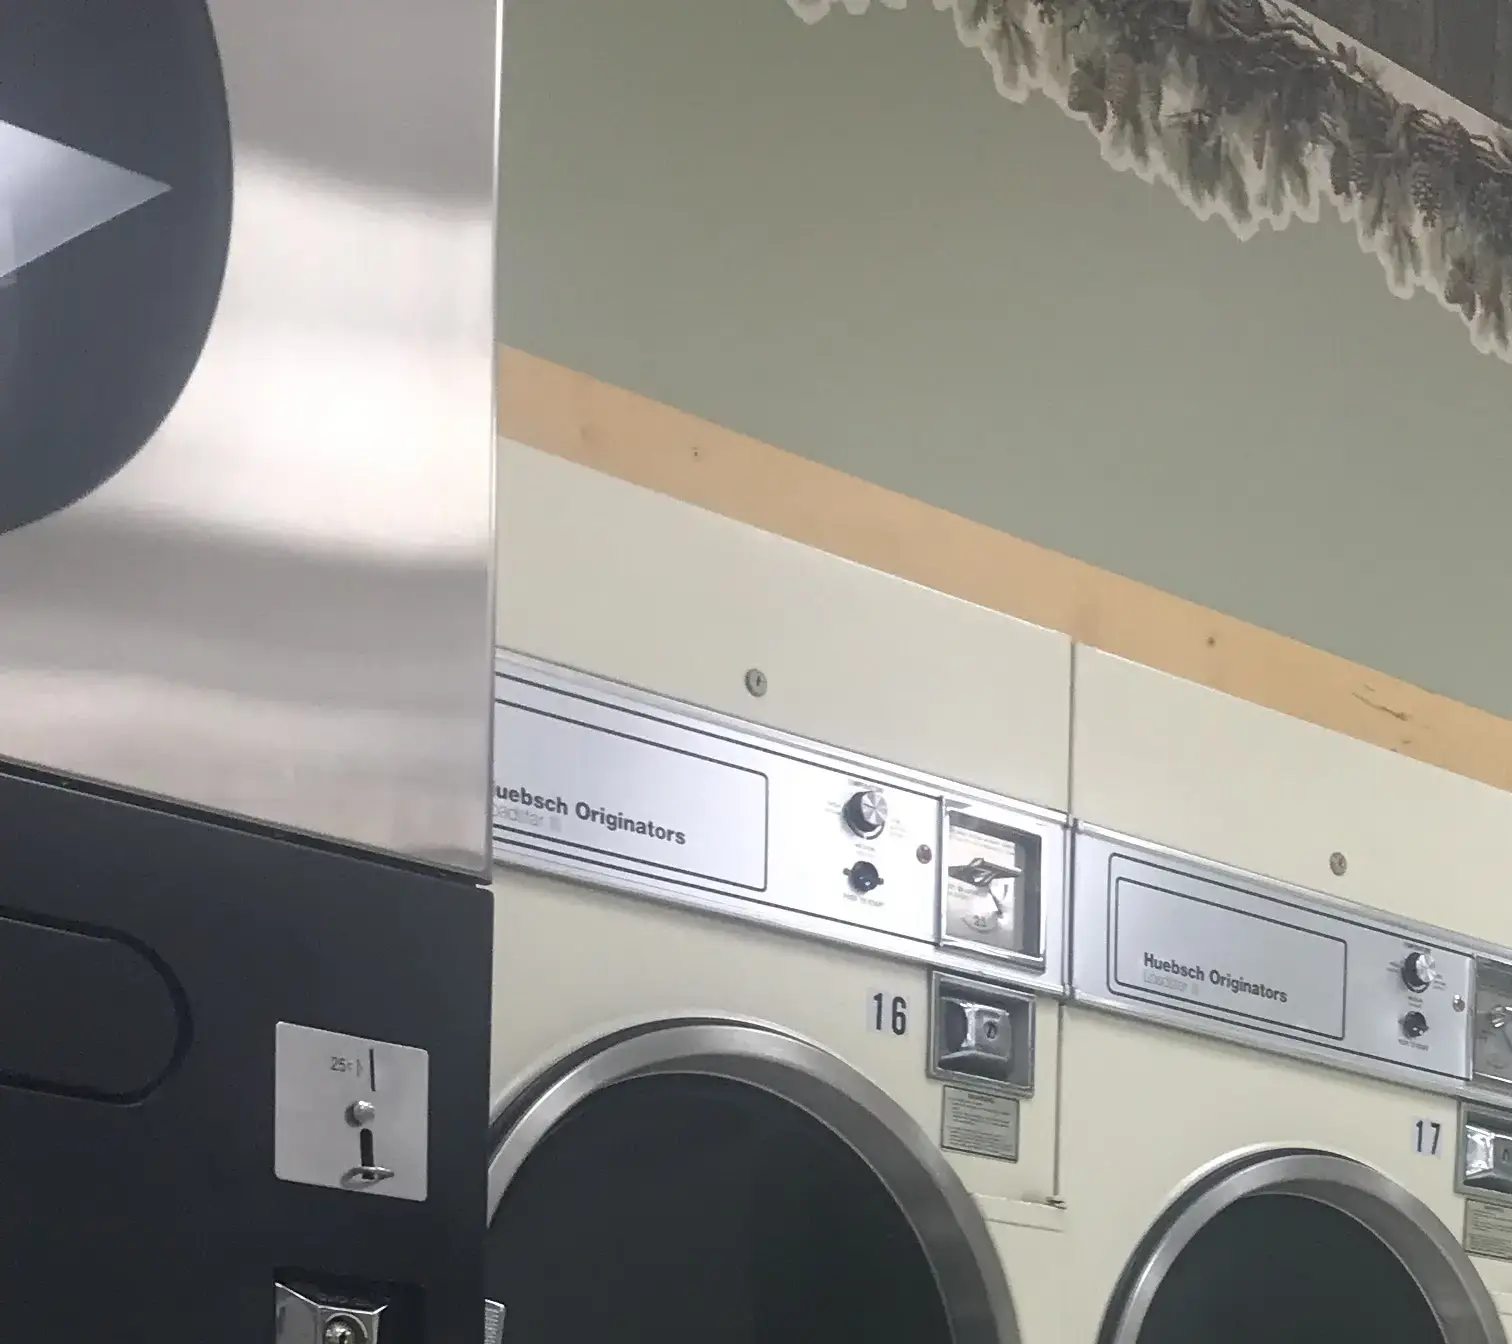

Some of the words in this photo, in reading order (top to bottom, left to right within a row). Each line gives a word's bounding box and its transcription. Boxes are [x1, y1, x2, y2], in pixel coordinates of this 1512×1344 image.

[575, 801, 686, 845] Originators
[1143, 951, 1205, 981] Huebsch
[1209, 969, 1288, 1003] Originators
[873, 992, 907, 1036] 16
[1416, 1119, 1441, 1155] 17
